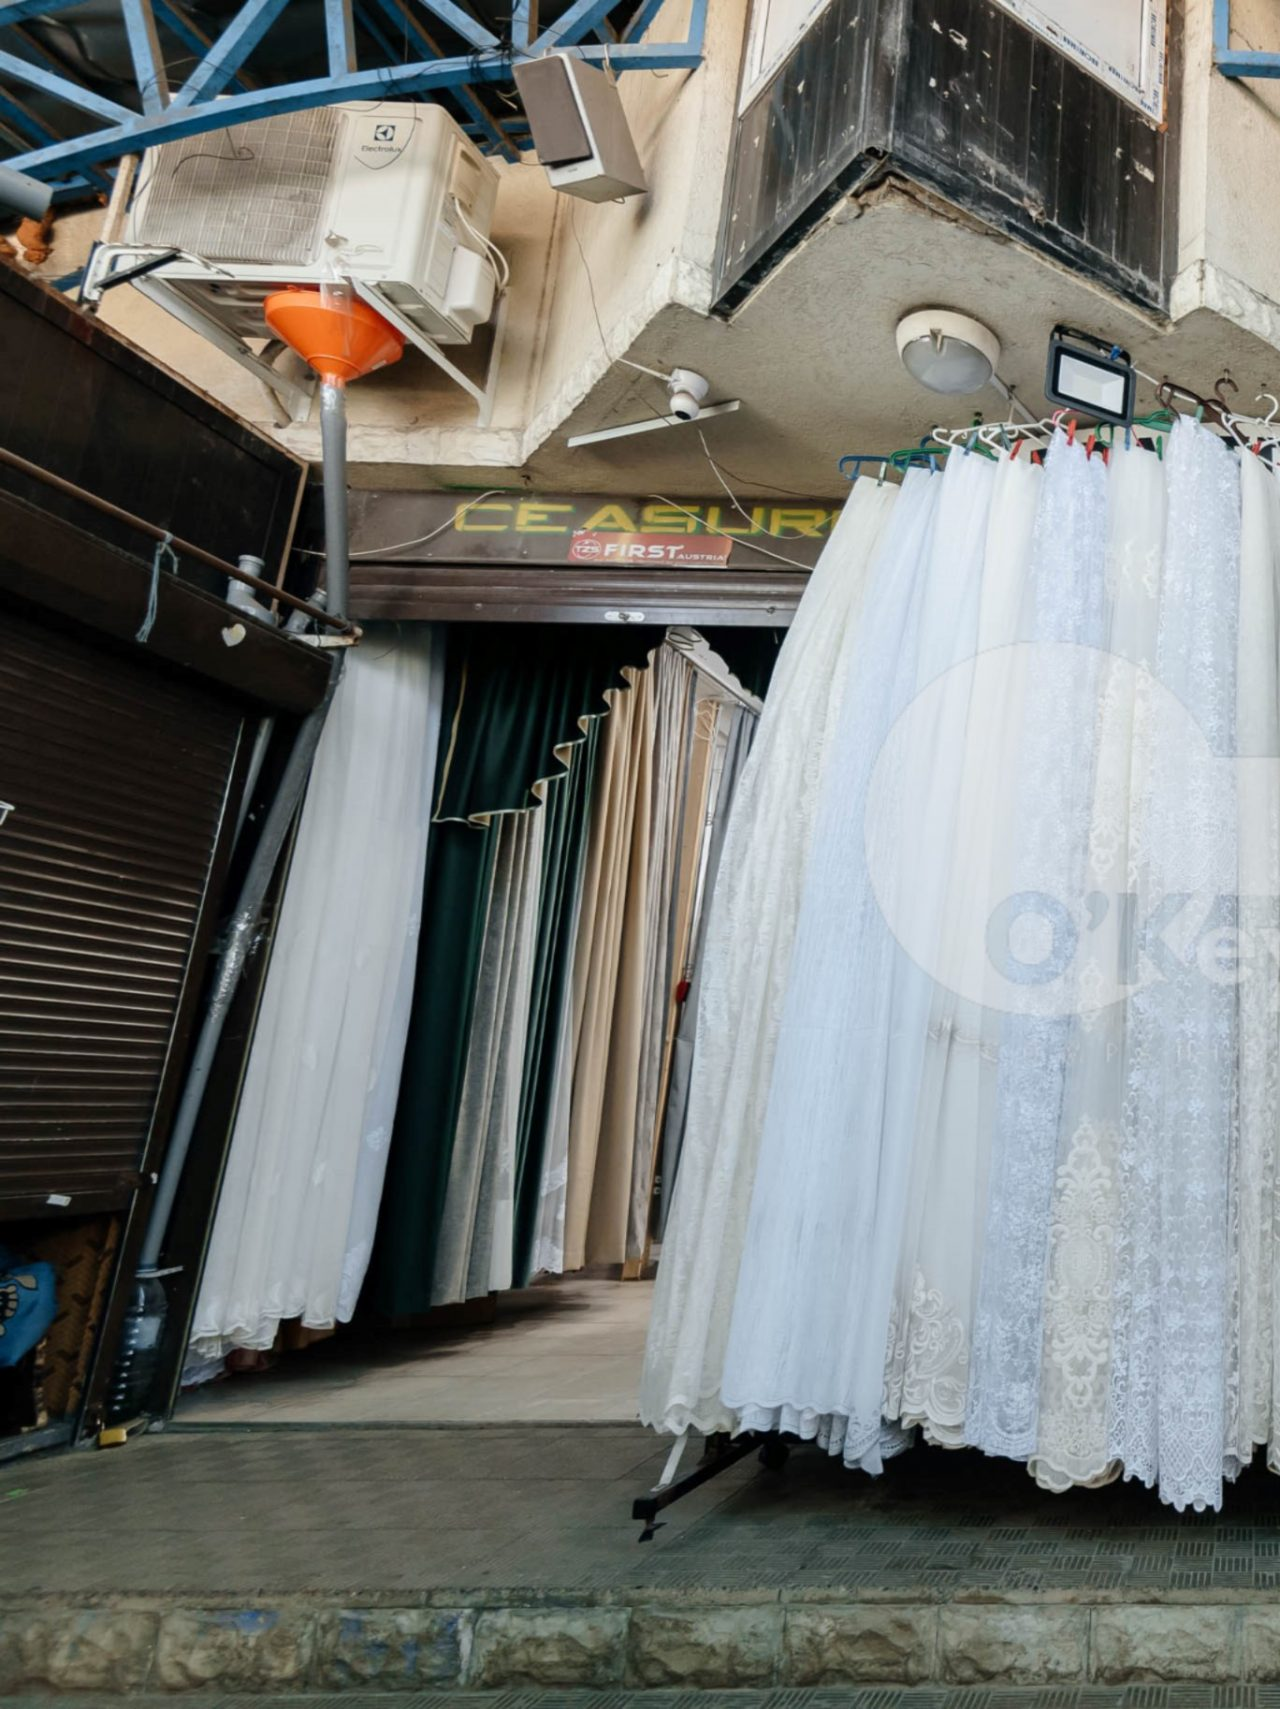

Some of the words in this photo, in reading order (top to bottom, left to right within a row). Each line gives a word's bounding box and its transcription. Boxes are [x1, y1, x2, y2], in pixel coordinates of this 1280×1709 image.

[361, 145, 404, 153] Electrolux
[454, 502, 843, 538] CEASUR
[604, 543, 685, 559] FIRST
[676, 553, 724, 562] AUSTRIA
